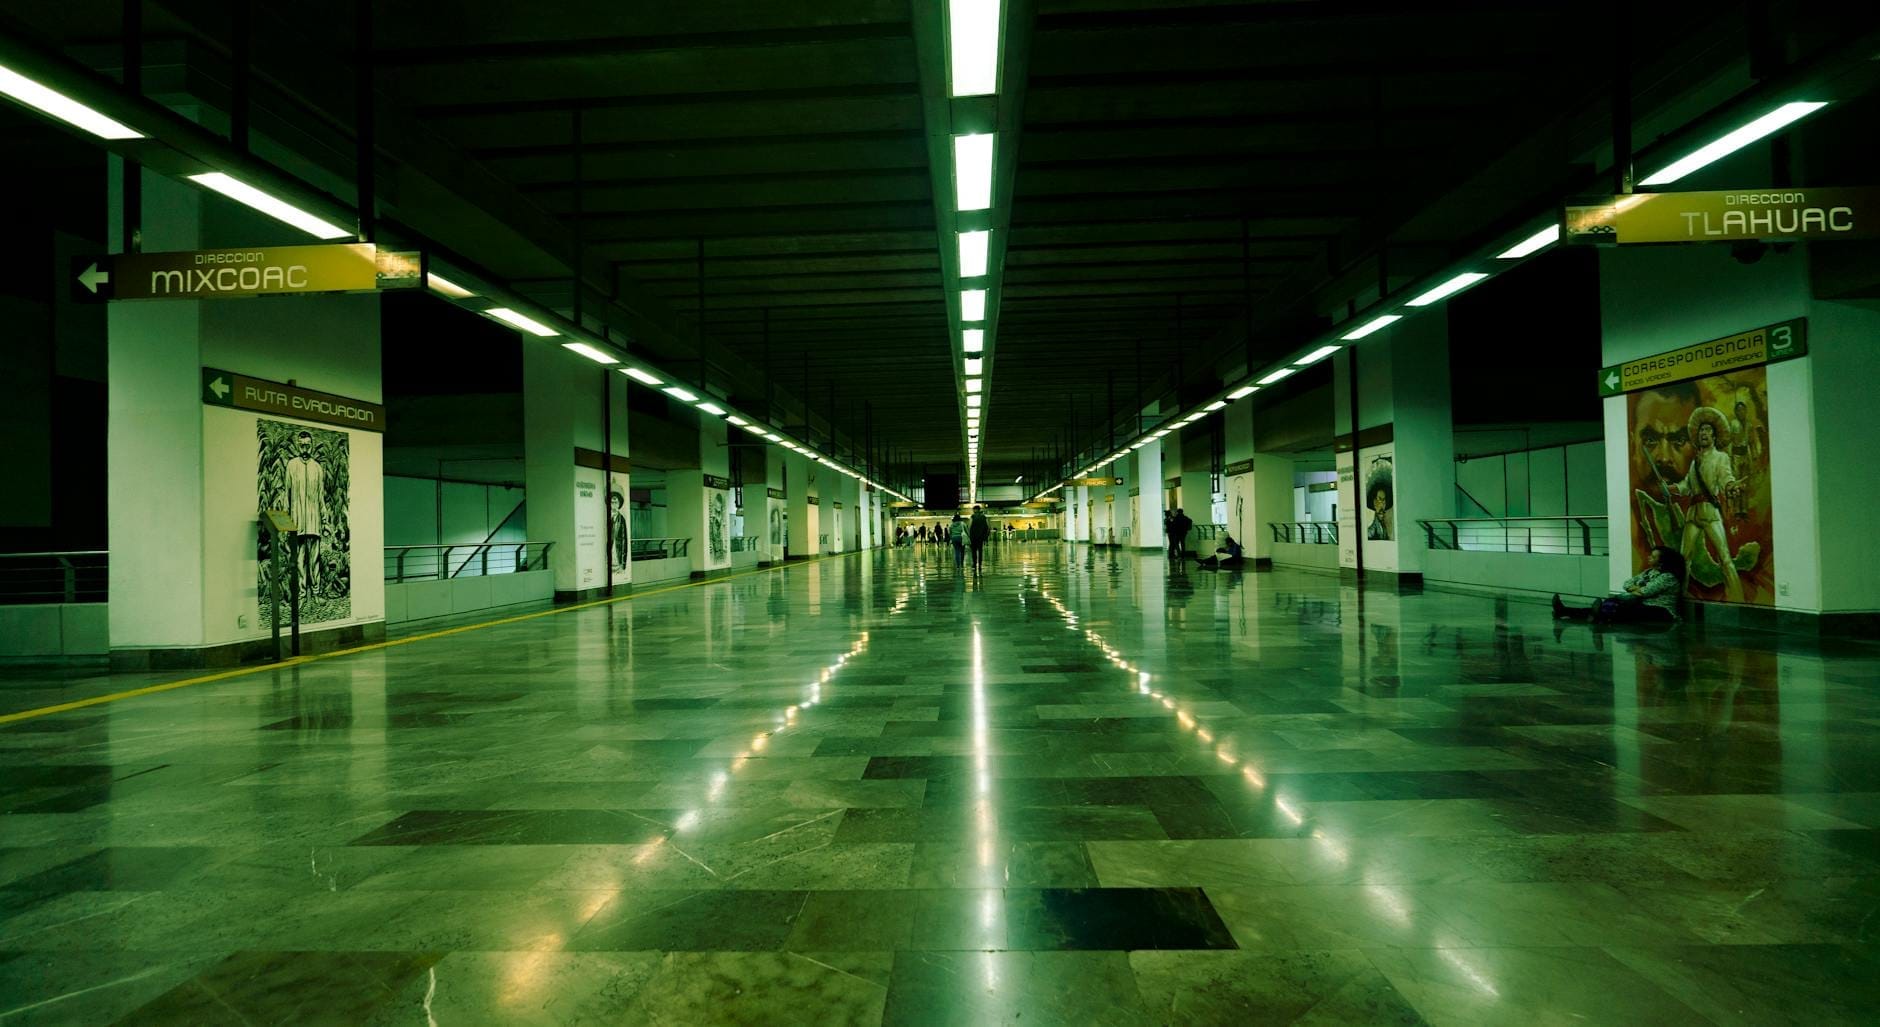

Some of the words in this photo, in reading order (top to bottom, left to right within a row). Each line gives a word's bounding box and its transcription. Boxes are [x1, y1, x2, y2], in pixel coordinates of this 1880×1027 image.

[1725, 191, 1805, 206] DIRECCION
[1680, 206, 1853, 236] TLAHUAC
[194, 252, 264, 265] DIRECCION
[151, 265, 308, 294] MIXCOAC
[1771, 326, 1792, 350] 3
[1623, 334, 1764, 378] CORRESPONDENCIA
[245, 385, 288, 407] RUTA
[292, 395, 374, 423] EVACUACION
